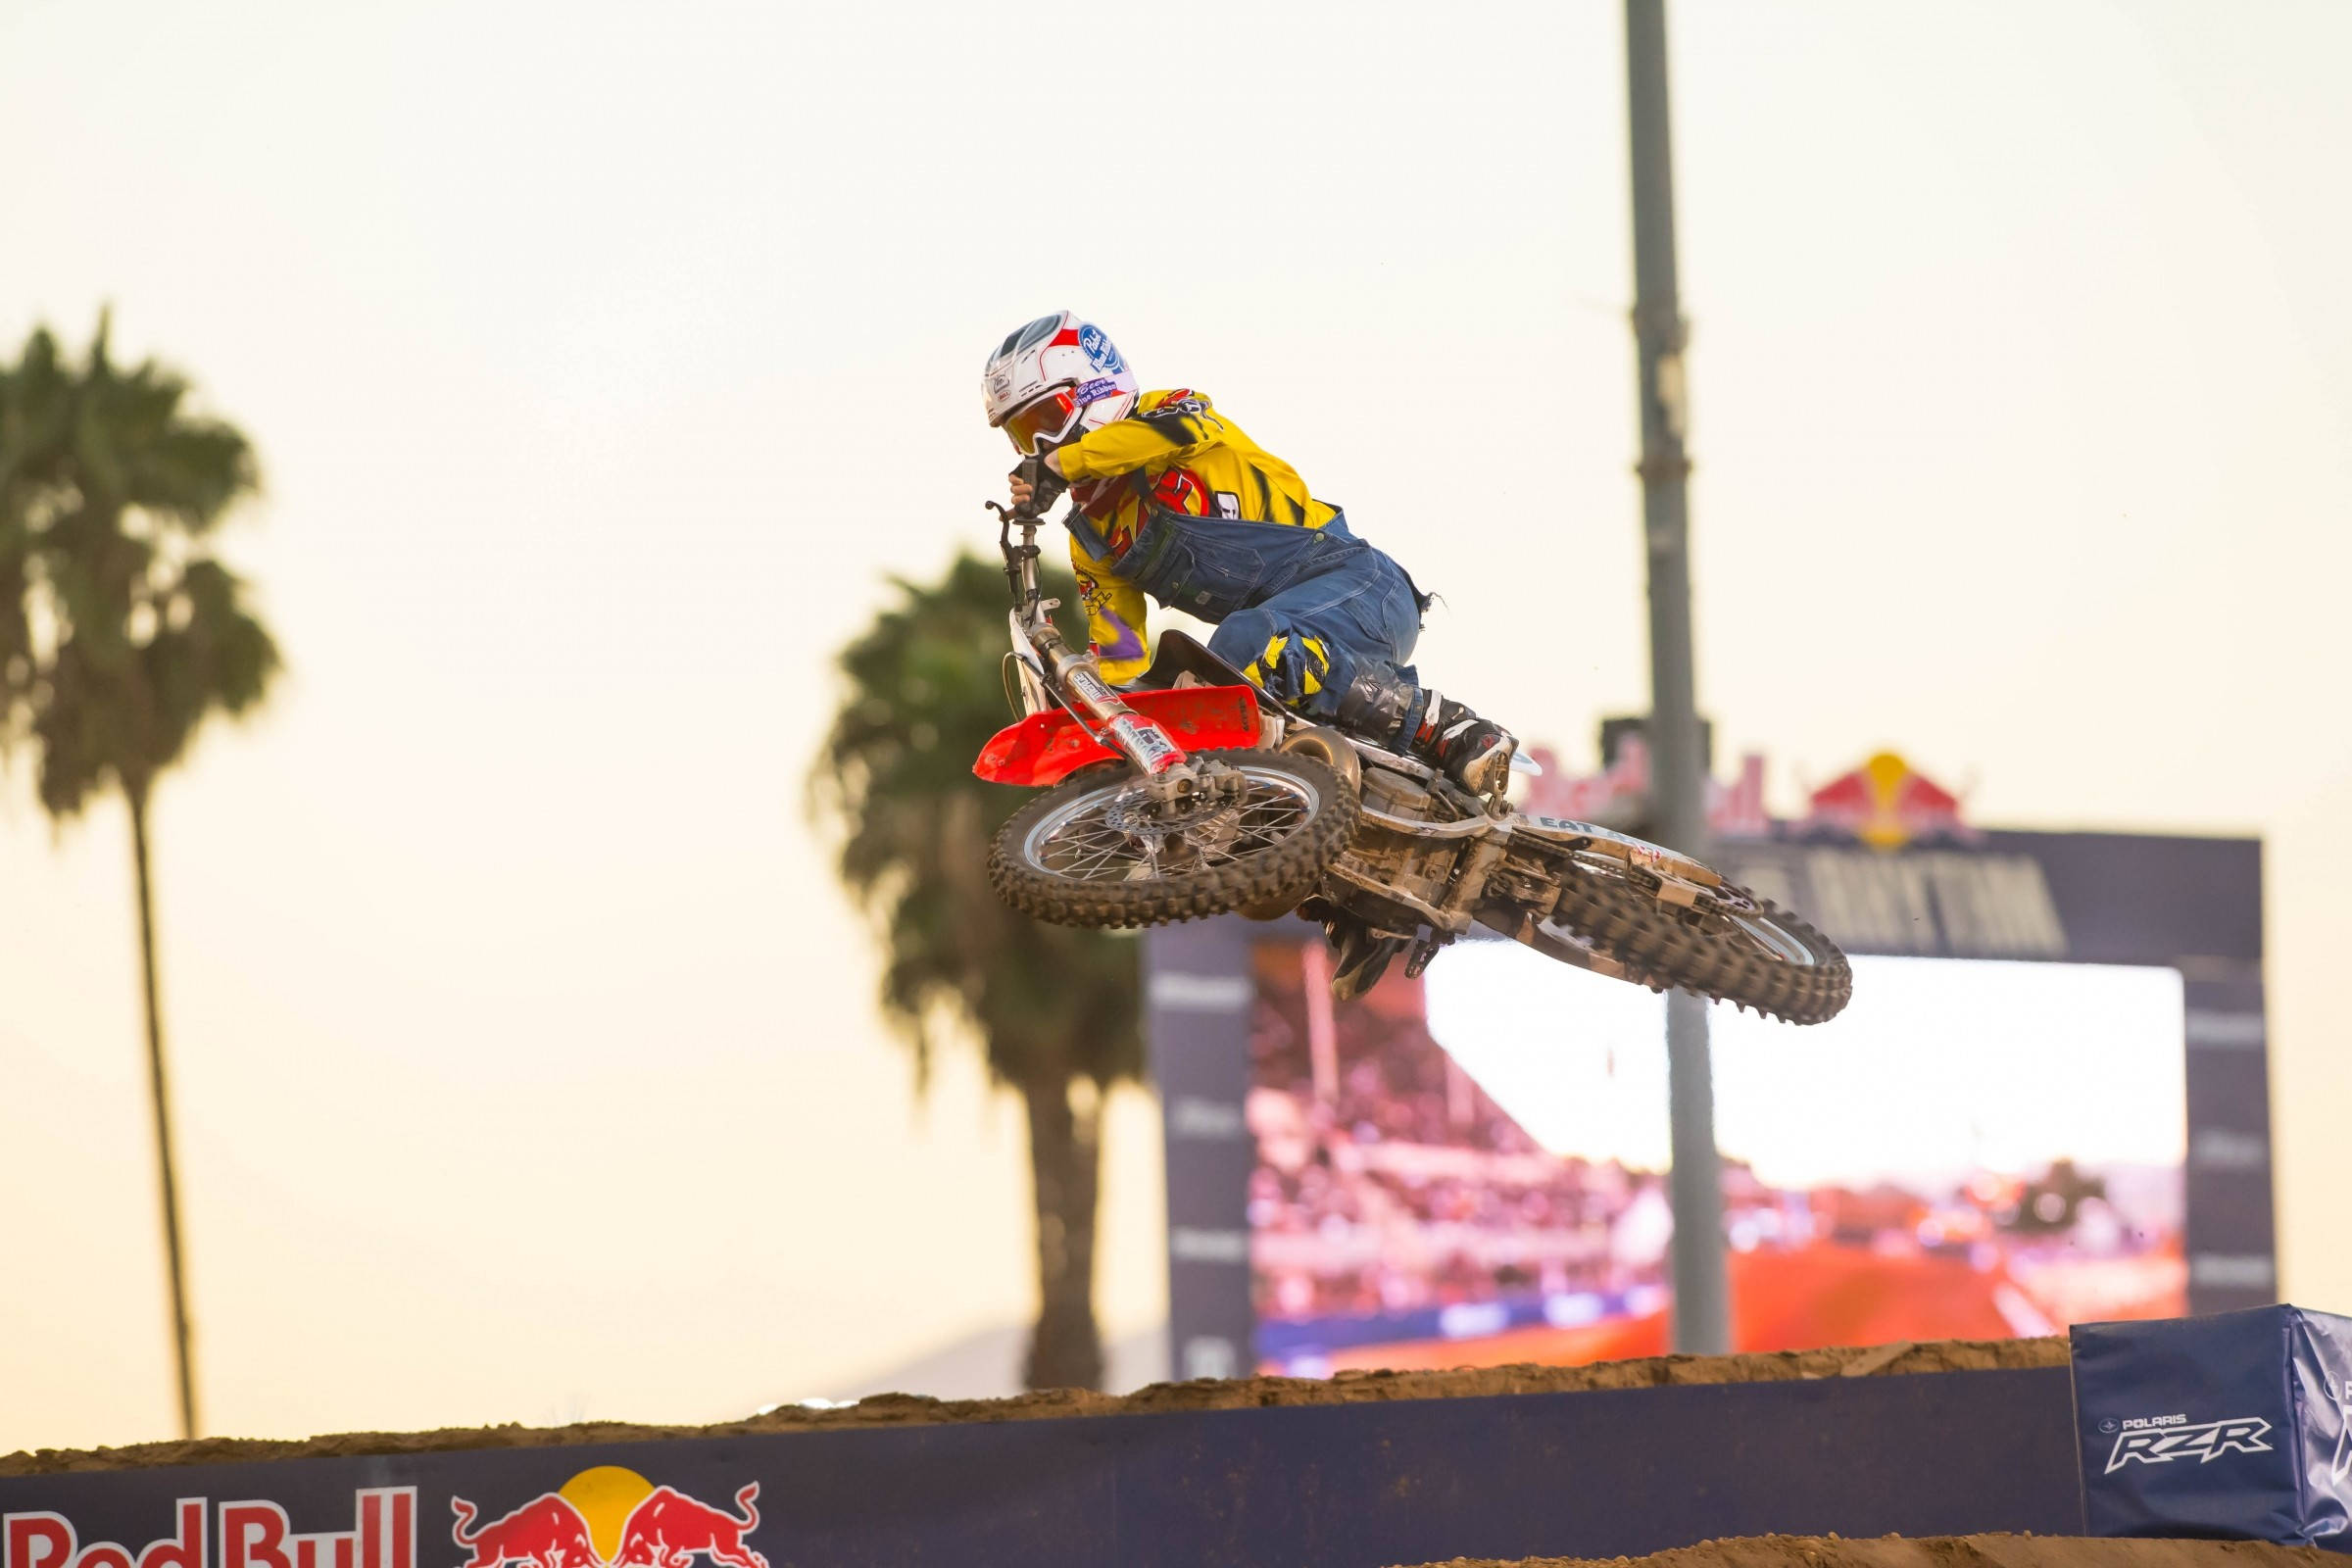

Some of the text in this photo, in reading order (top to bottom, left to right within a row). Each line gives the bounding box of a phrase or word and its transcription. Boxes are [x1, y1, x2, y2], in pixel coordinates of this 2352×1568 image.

[1540, 816, 1592, 833] EAT
[2122, 1413, 2186, 1431] POLARIS
[2104, 1416, 2274, 1475] RZR
